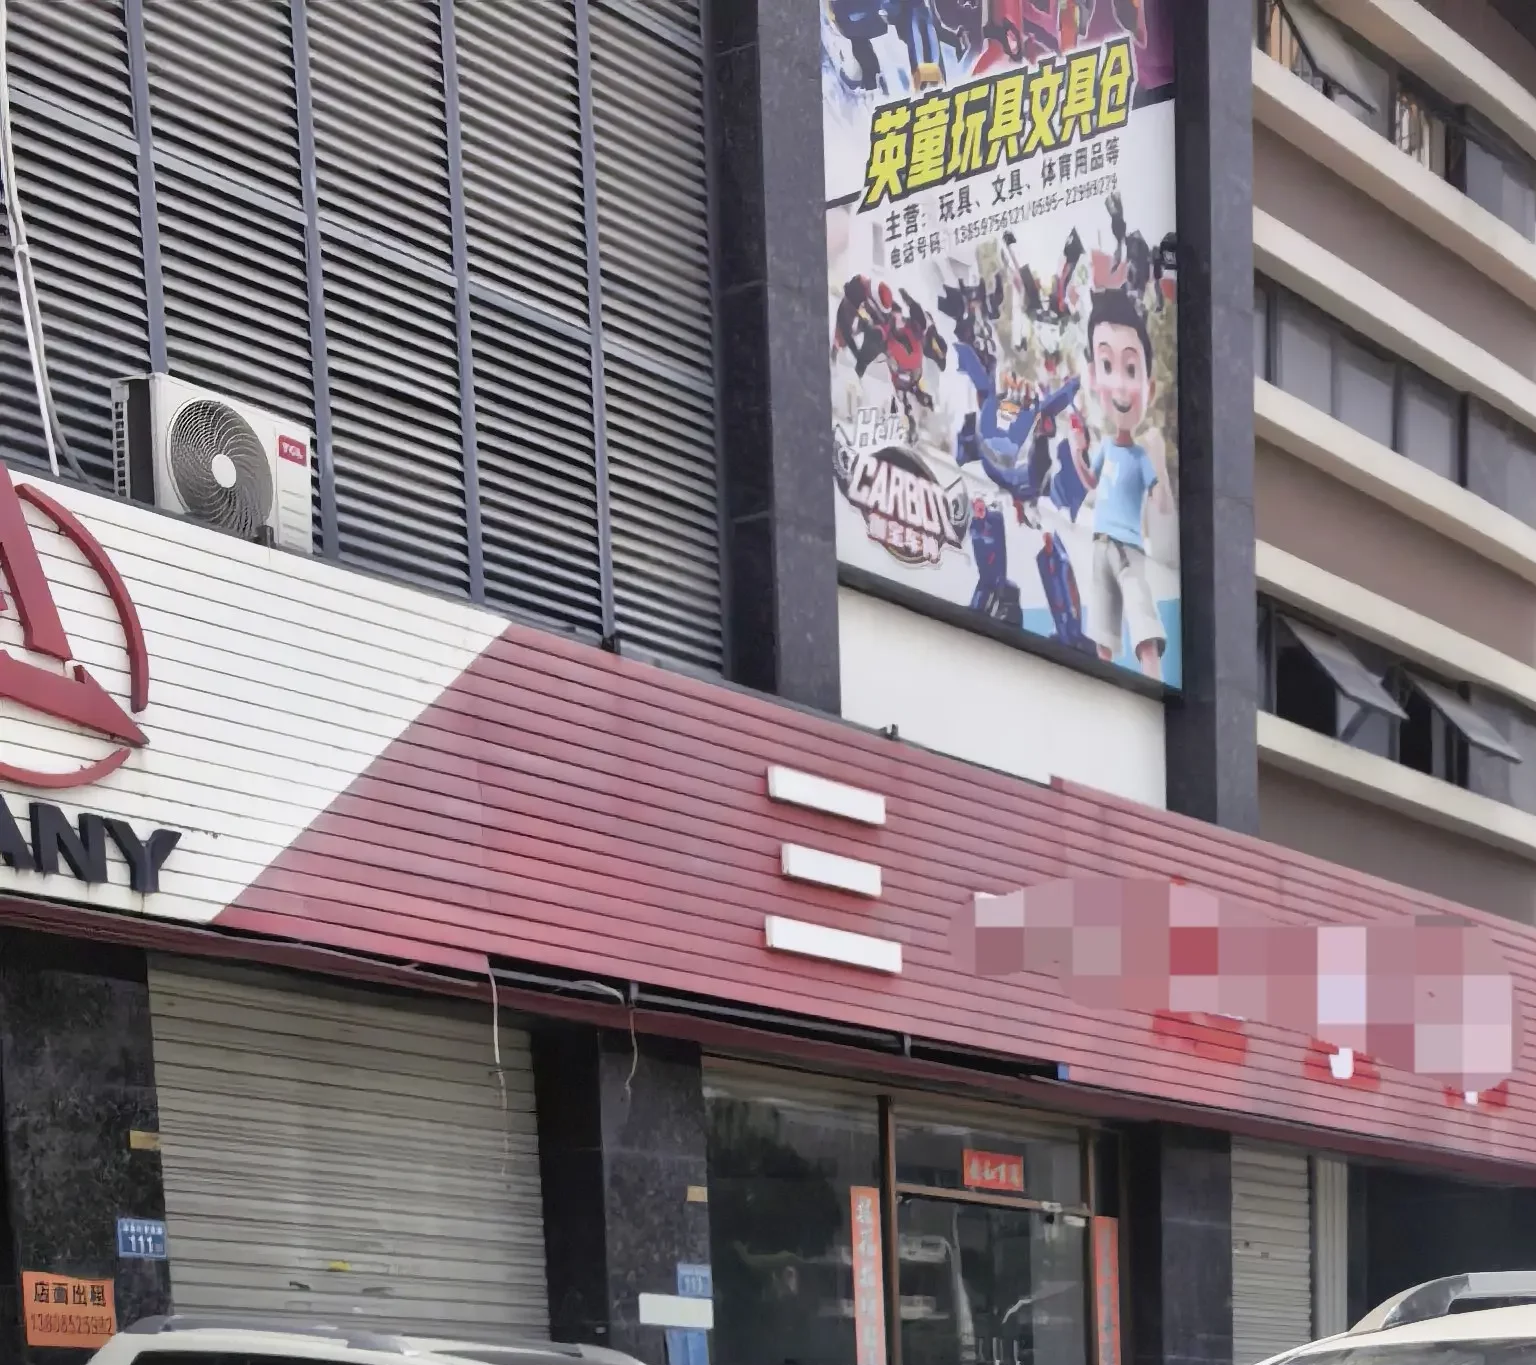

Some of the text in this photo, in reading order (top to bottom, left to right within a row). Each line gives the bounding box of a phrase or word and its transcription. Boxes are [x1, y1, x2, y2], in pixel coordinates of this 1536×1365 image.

[866, 44, 1133, 204] 英童玩具文具仓
